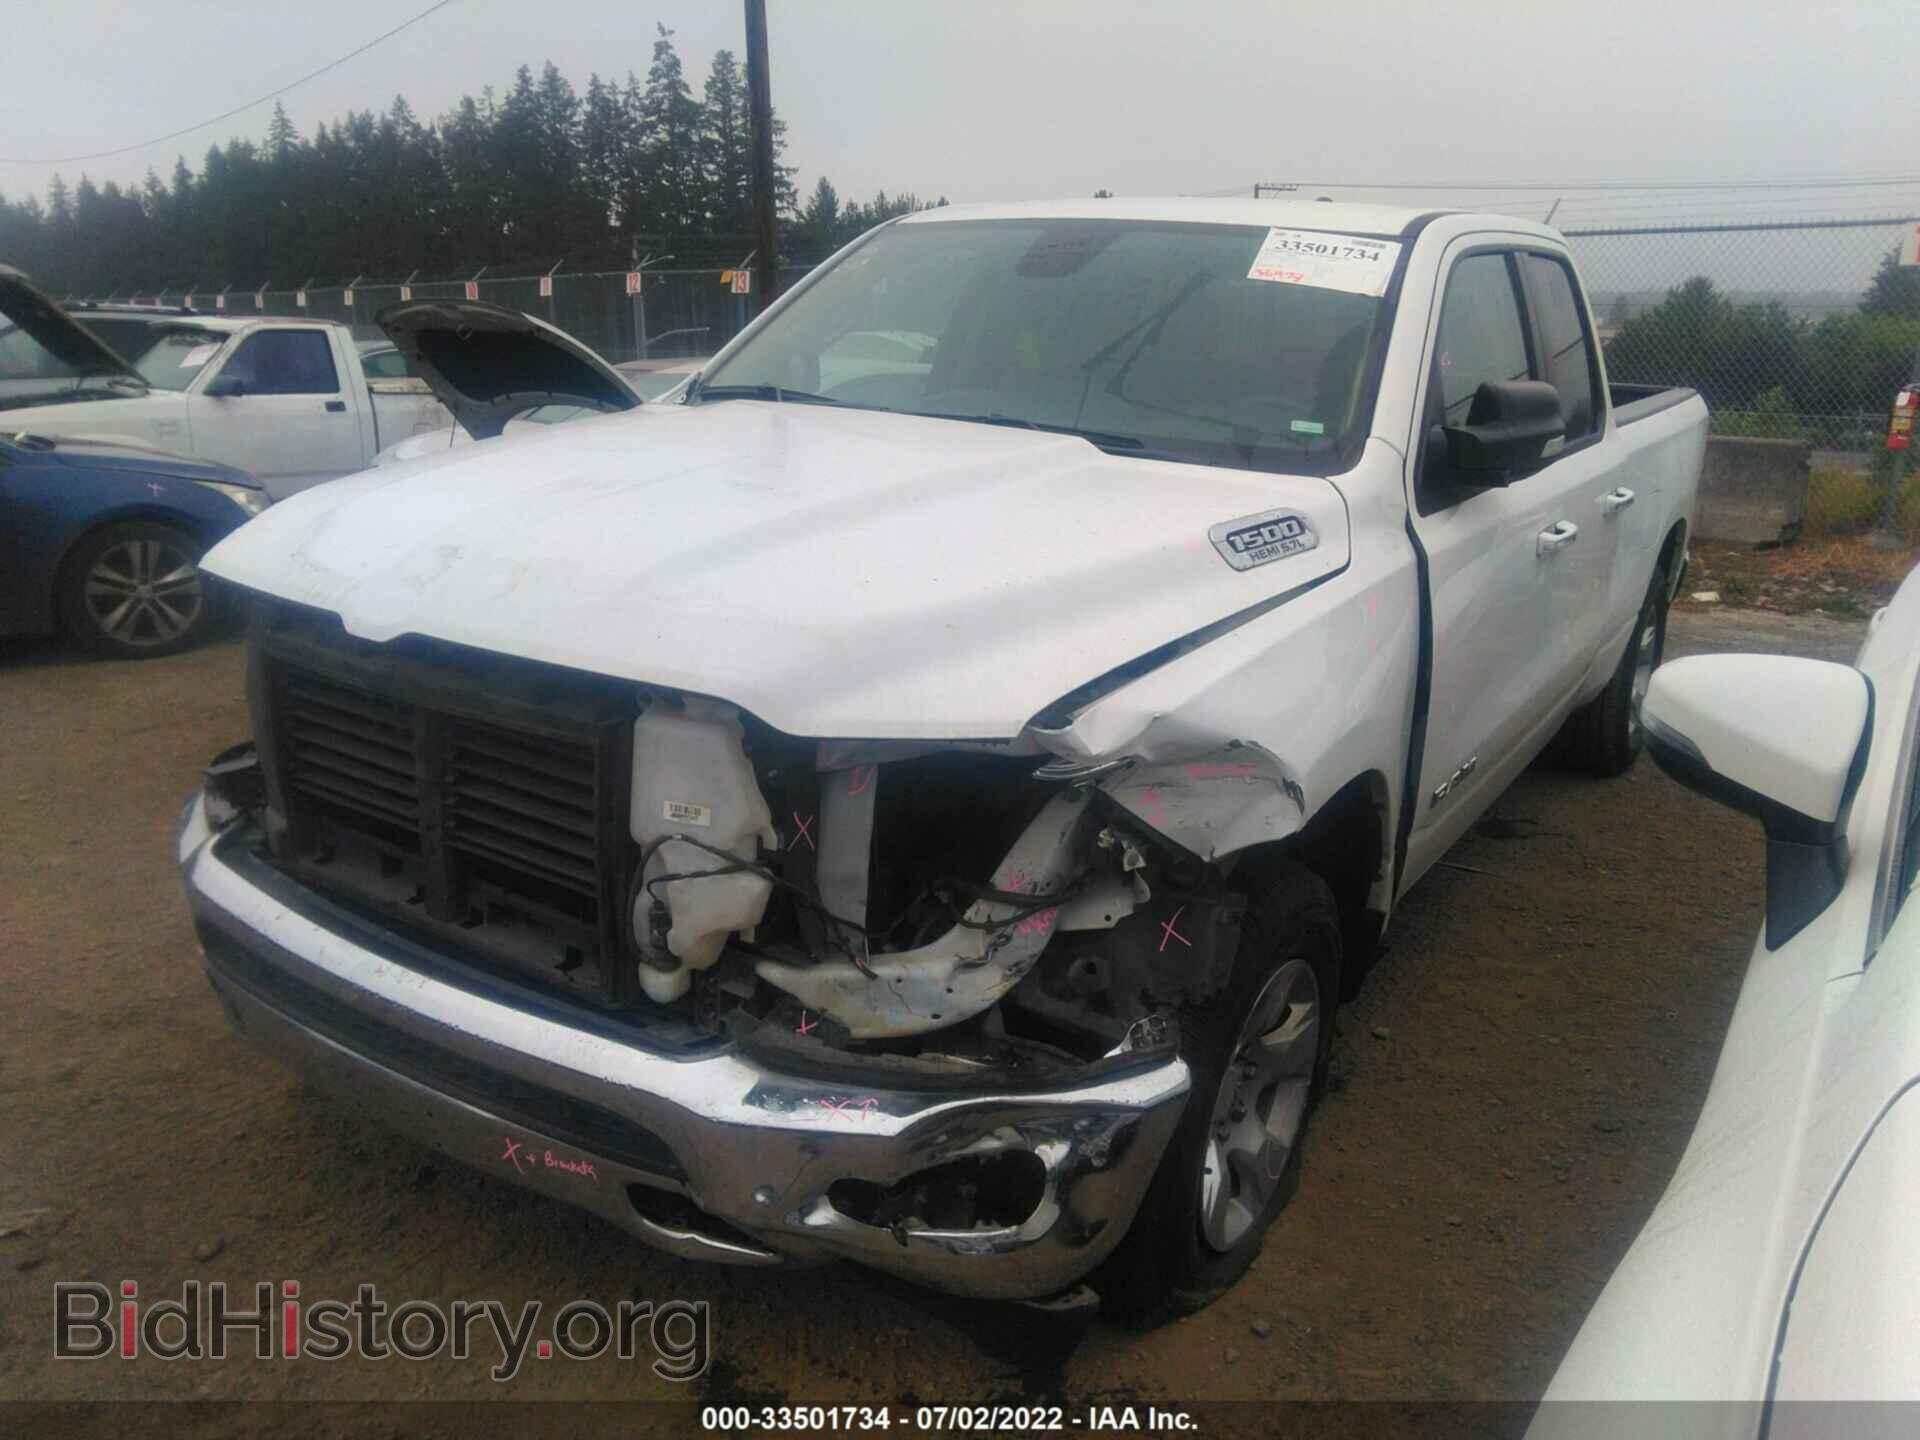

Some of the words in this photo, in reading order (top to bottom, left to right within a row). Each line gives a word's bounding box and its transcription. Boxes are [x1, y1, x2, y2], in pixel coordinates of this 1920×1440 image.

[1275, 239, 1380, 262] 33501734
[1229, 519, 1302, 553] 1500
[1248, 547, 1281, 562] HEMI
[1281, 539, 1305, 553] 5.7L
